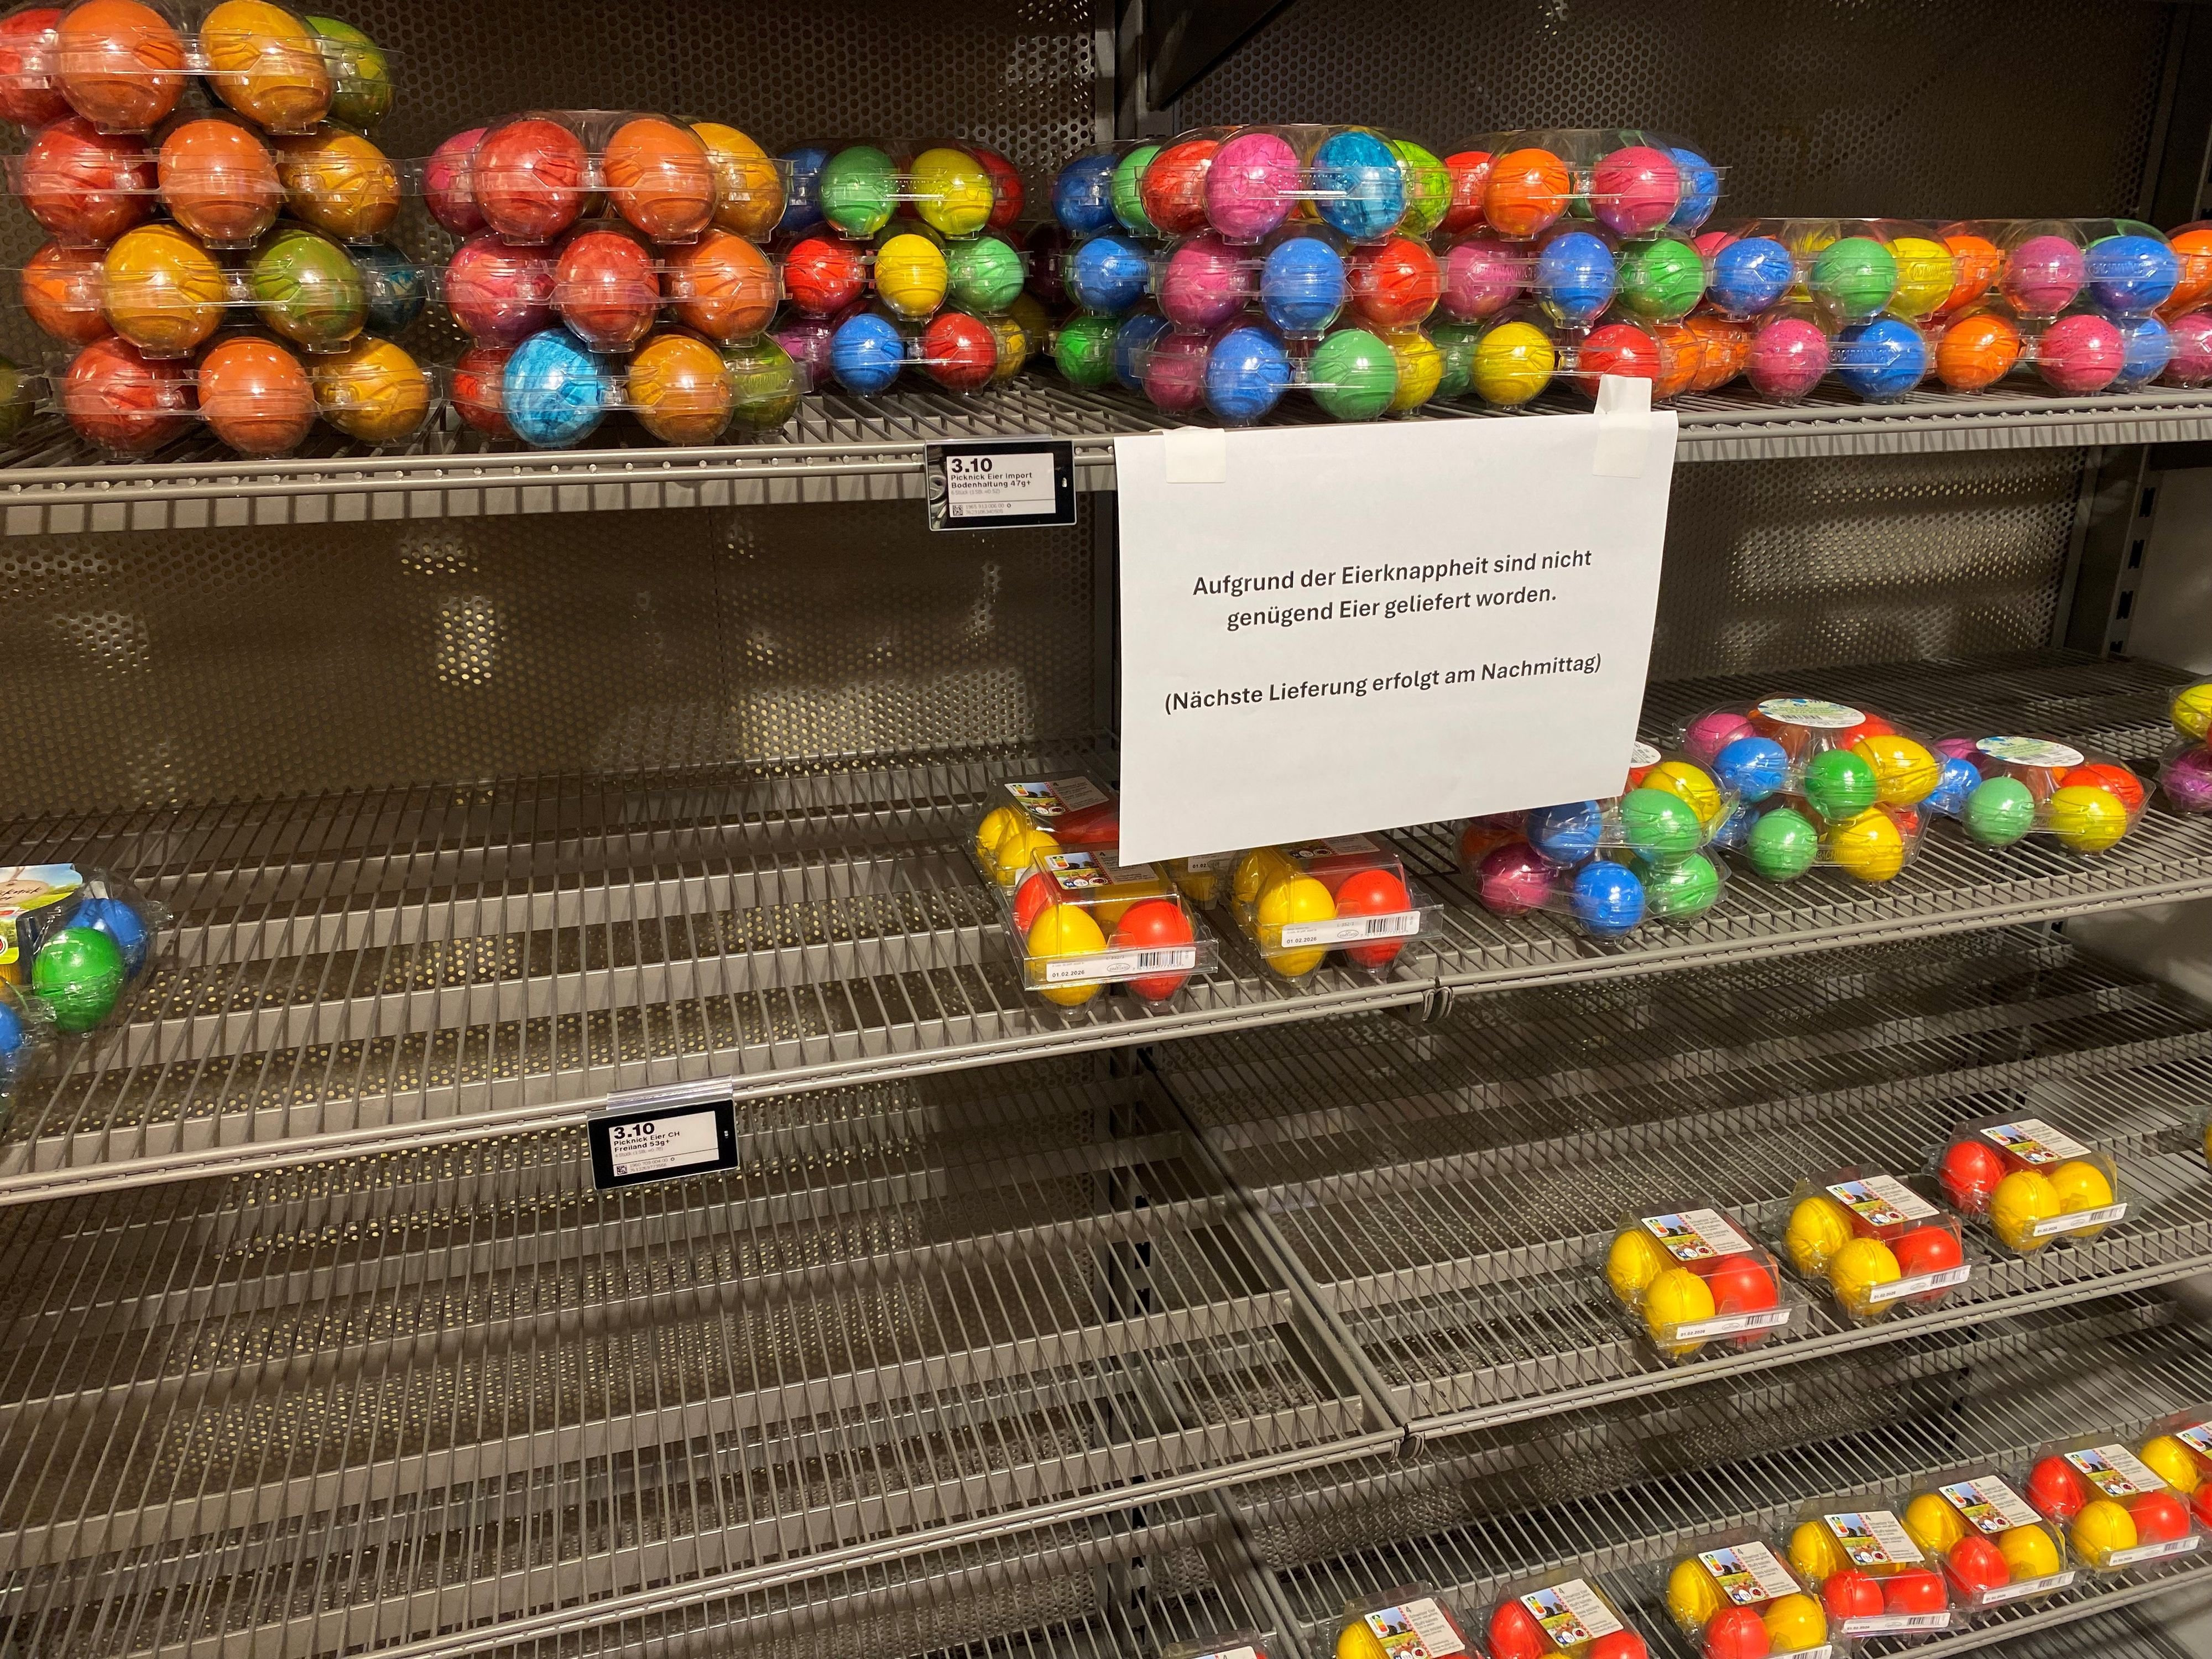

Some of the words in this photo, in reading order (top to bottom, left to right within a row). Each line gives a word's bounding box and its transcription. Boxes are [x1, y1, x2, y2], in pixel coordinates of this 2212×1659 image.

[951, 458, 993, 473] 3.10
[1193, 571, 1294, 597] Aufgrund
[1301, 570, 1336, 587] der
[1343, 557, 1489, 585] Eierknappheit
[1494, 553, 1536, 572] sind
[1542, 550, 1592, 569] nicht
[1228, 602, 1333, 631] genügend
[1340, 600, 1380, 618] Eier
[1385, 592, 1471, 618] geliefert
[1477, 587, 1556, 607] worden.
[1166, 688, 1262, 714] (Nächste
[1270, 679, 1368, 701] Lieferung
[1373, 669, 1440, 691] erfolgt
[1445, 670, 1475, 684] am
[1482, 653, 1601, 680] Nachmittag)
[1052, 969, 1085, 978] 01.02.2026
[614, 1123, 655, 1139] 3.10
[614, 1136, 648, 1146] Picknick
[614, 1142, 647, 1152] Freiland
[650, 1139, 670, 1147] 53g+
